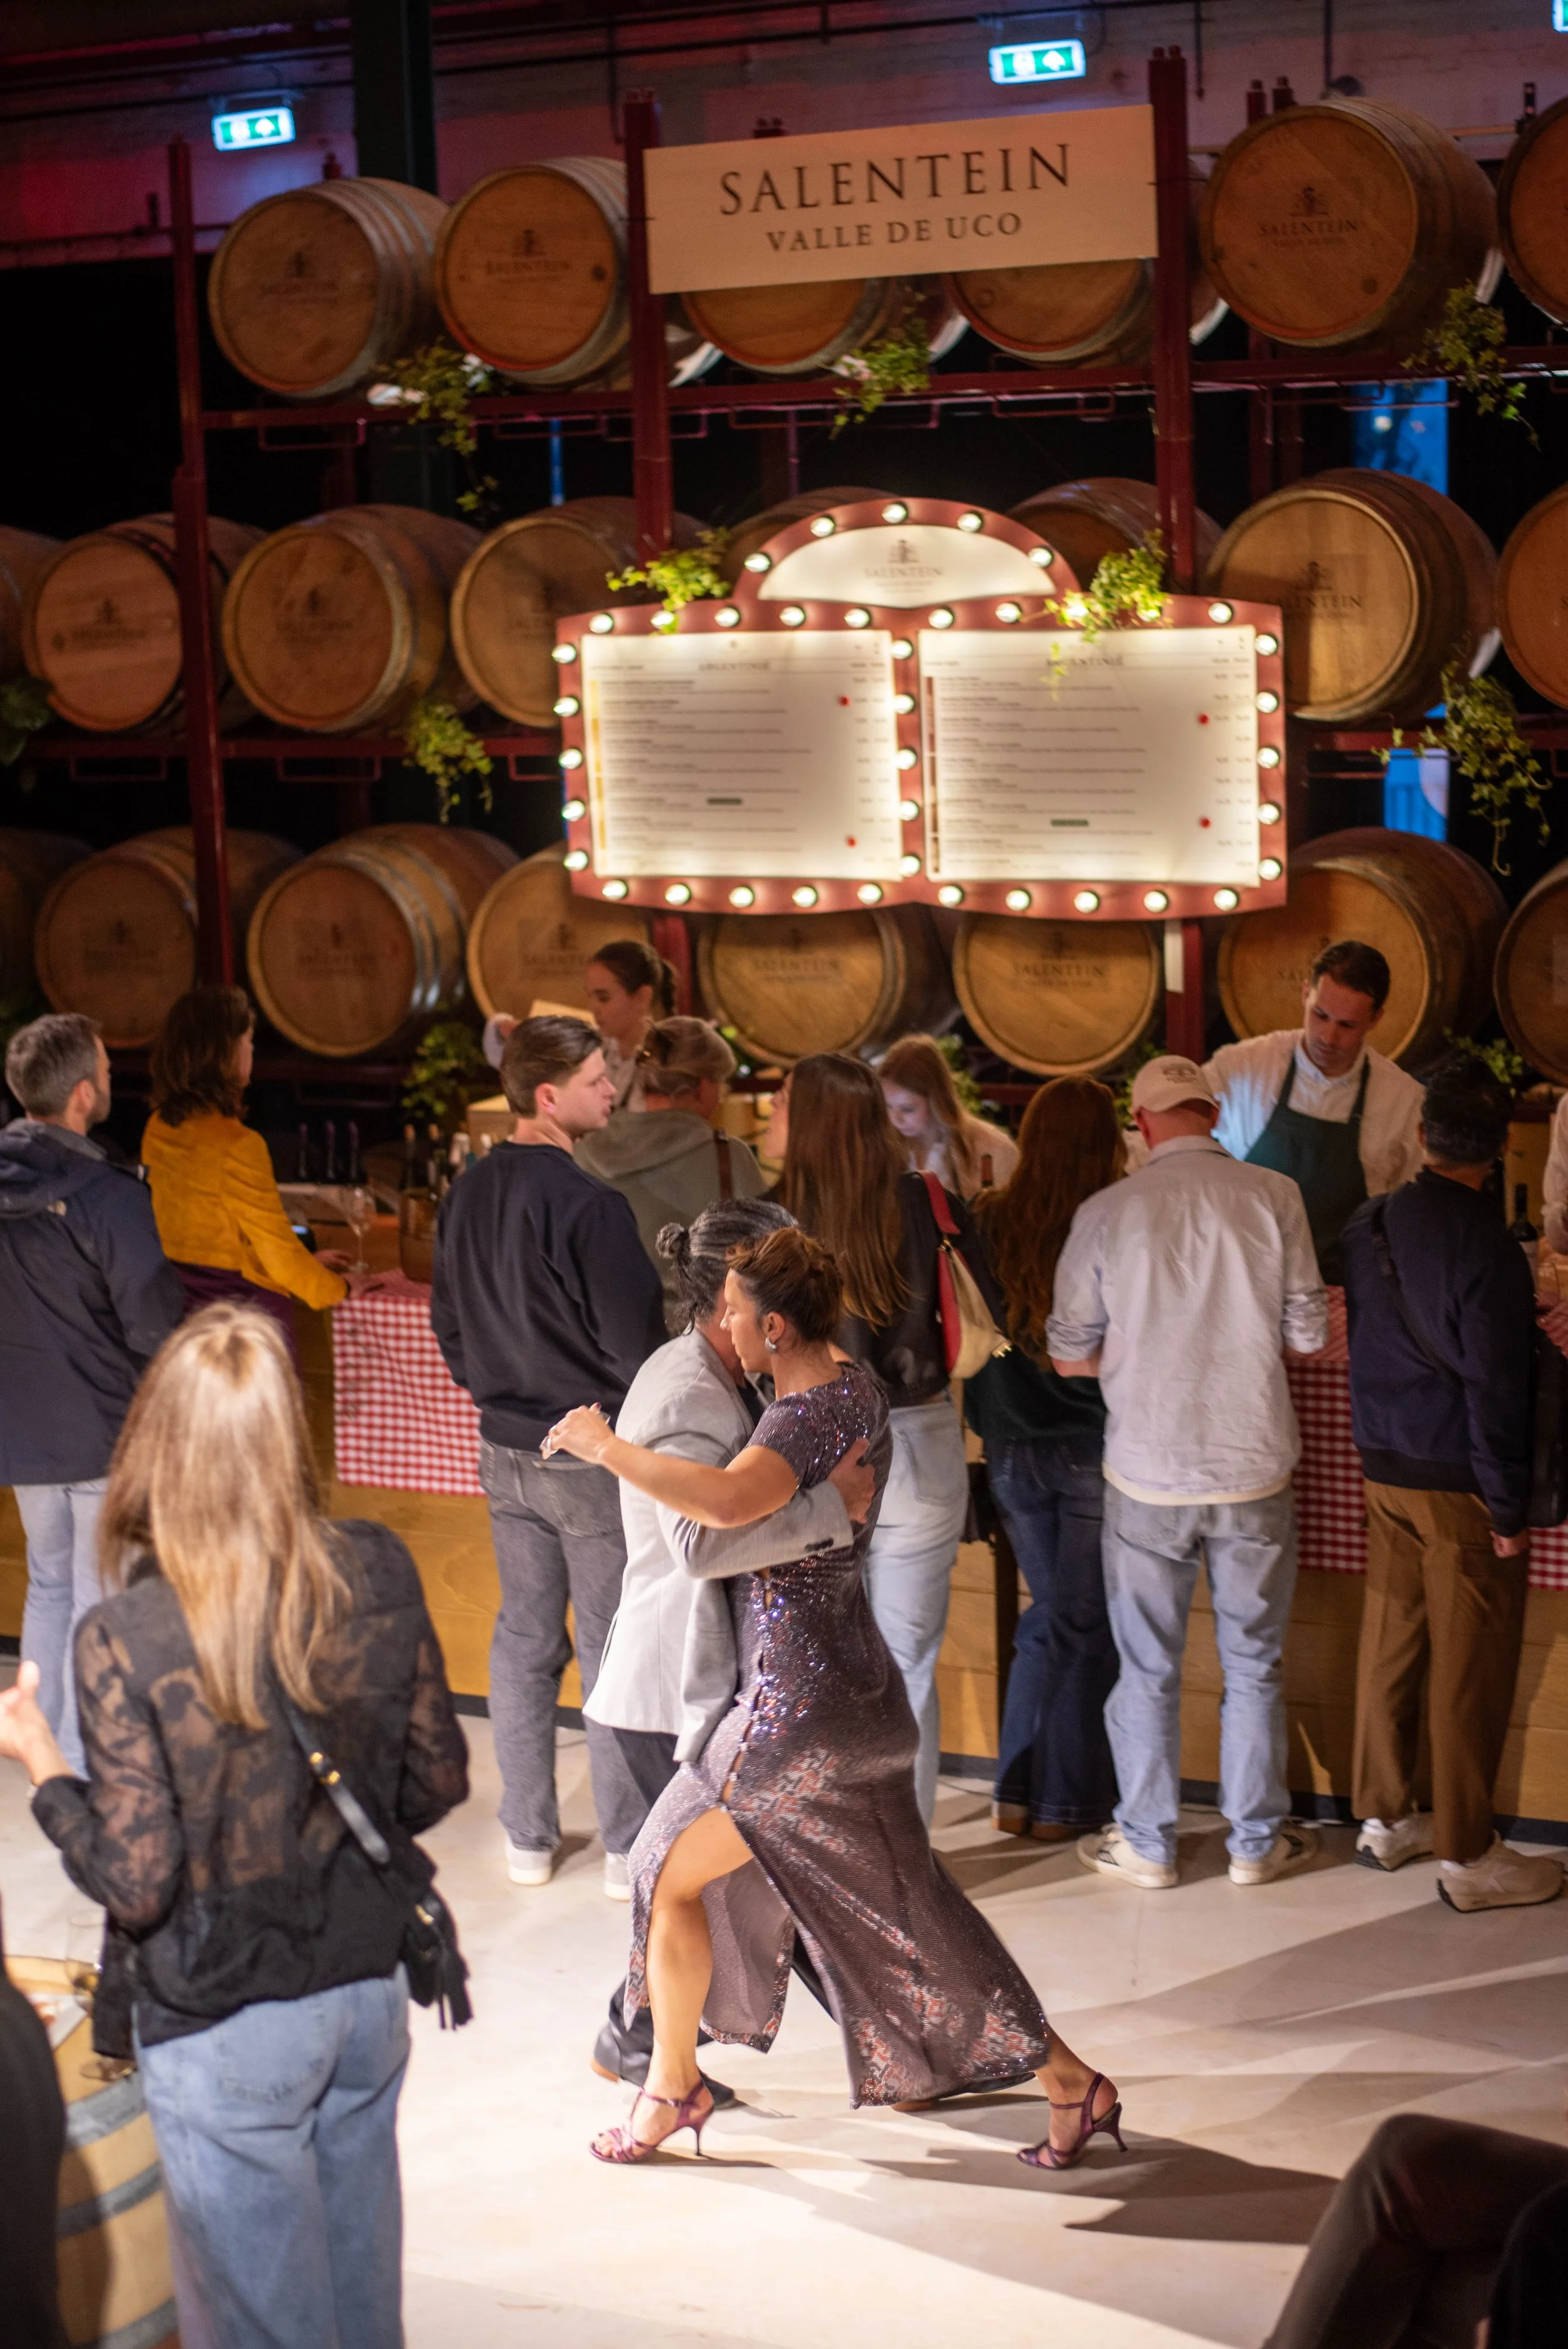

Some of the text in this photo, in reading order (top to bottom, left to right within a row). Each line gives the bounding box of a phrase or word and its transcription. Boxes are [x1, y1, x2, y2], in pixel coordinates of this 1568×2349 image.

[719, 144, 1070, 215] SALENTEIN
[766, 213, 1022, 253] VALLE DE UCO
[1258, 218, 1358, 236] SALENTEIN
[1014, 963, 1106, 978] SALENTEIN
